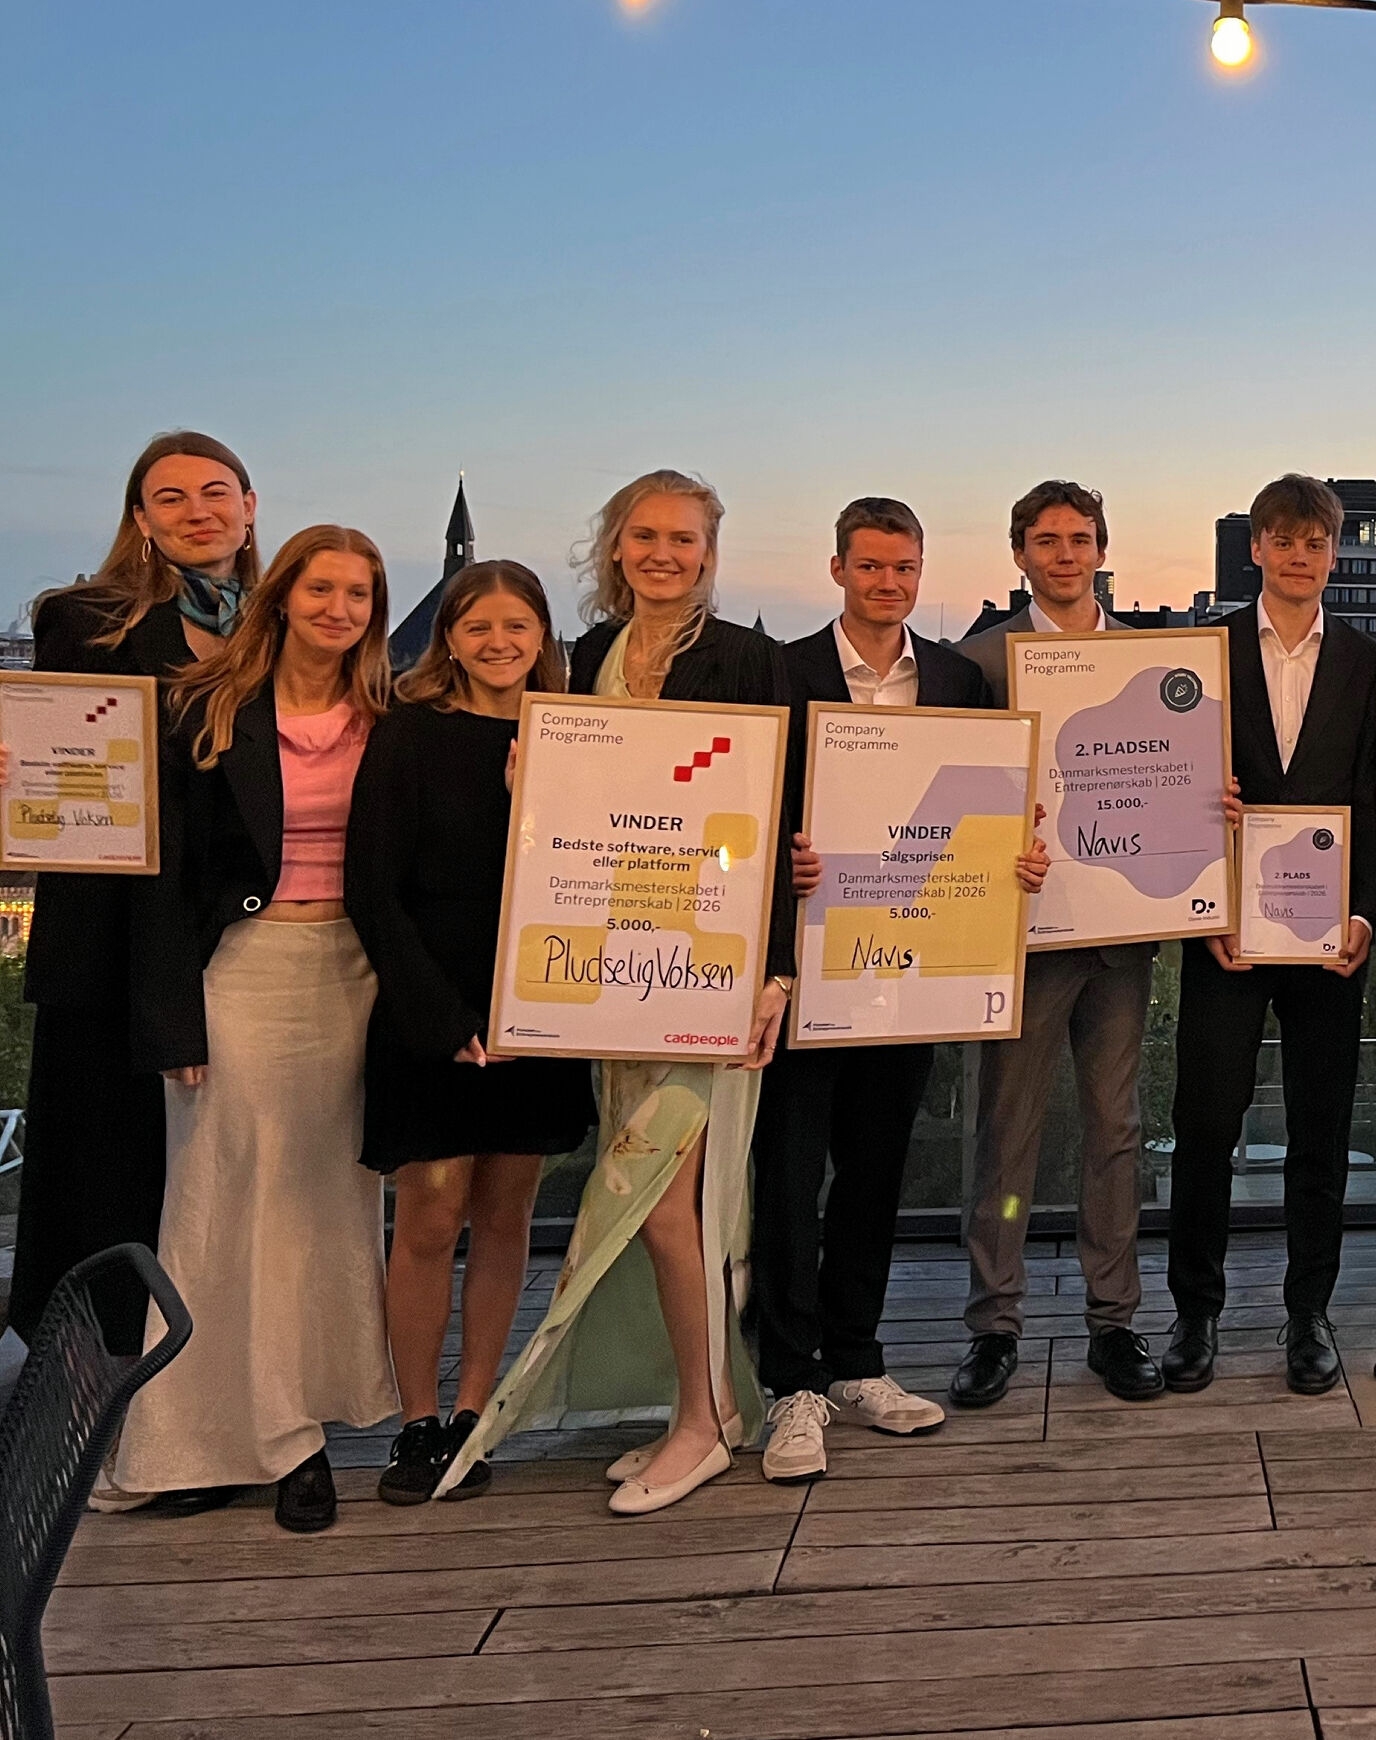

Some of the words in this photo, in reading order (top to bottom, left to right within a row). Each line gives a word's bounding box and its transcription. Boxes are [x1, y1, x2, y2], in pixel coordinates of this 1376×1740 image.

[1024, 649, 1081, 662] Company
[1024, 662, 1095, 675] Programme
[542, 712, 609, 729] Company
[540, 729, 623, 745] Programme
[825, 722, 885, 737] Company
[825, 738, 899, 751] Programme
[1075, 744, 1089, 757] 2.
[1093, 740, 1170, 756] PLADSEN
[1049, 763, 1188, 779] Danmarksmesterskabet
[1055, 777, 1153, 793] Entreprenørskab
[1161, 775, 1192, 787] 2026
[1097, 799, 1148, 812] 15.000,-
[610, 813, 683, 832] VINDER
[888, 825, 952, 840] VINDER
[1077, 821, 1141, 858] Navis
[552, 838, 603, 852] Bedste
[607, 841, 675, 857] software,
[678, 844, 723, 858] servic
[592, 857, 624, 870] eller
[627, 859, 690, 873] platform
[881, 851, 954, 865] Salgsprisen
[838, 872, 985, 884] Danmarksmesterskabet
[549, 877, 719, 896] Danmarksmesterskabet
[843, 887, 946, 900] Entreprenørskab
[954, 887, 986, 898] 2026
[554, 893, 673, 911] Entreprenørskab
[683, 899, 721, 912] 2026
[889, 907, 936, 921] 5.000,-
[607, 919, 661, 934] 5.000,-
[851, 934, 914, 970] Navis
[664, 1033, 739, 1046] cadpeople
